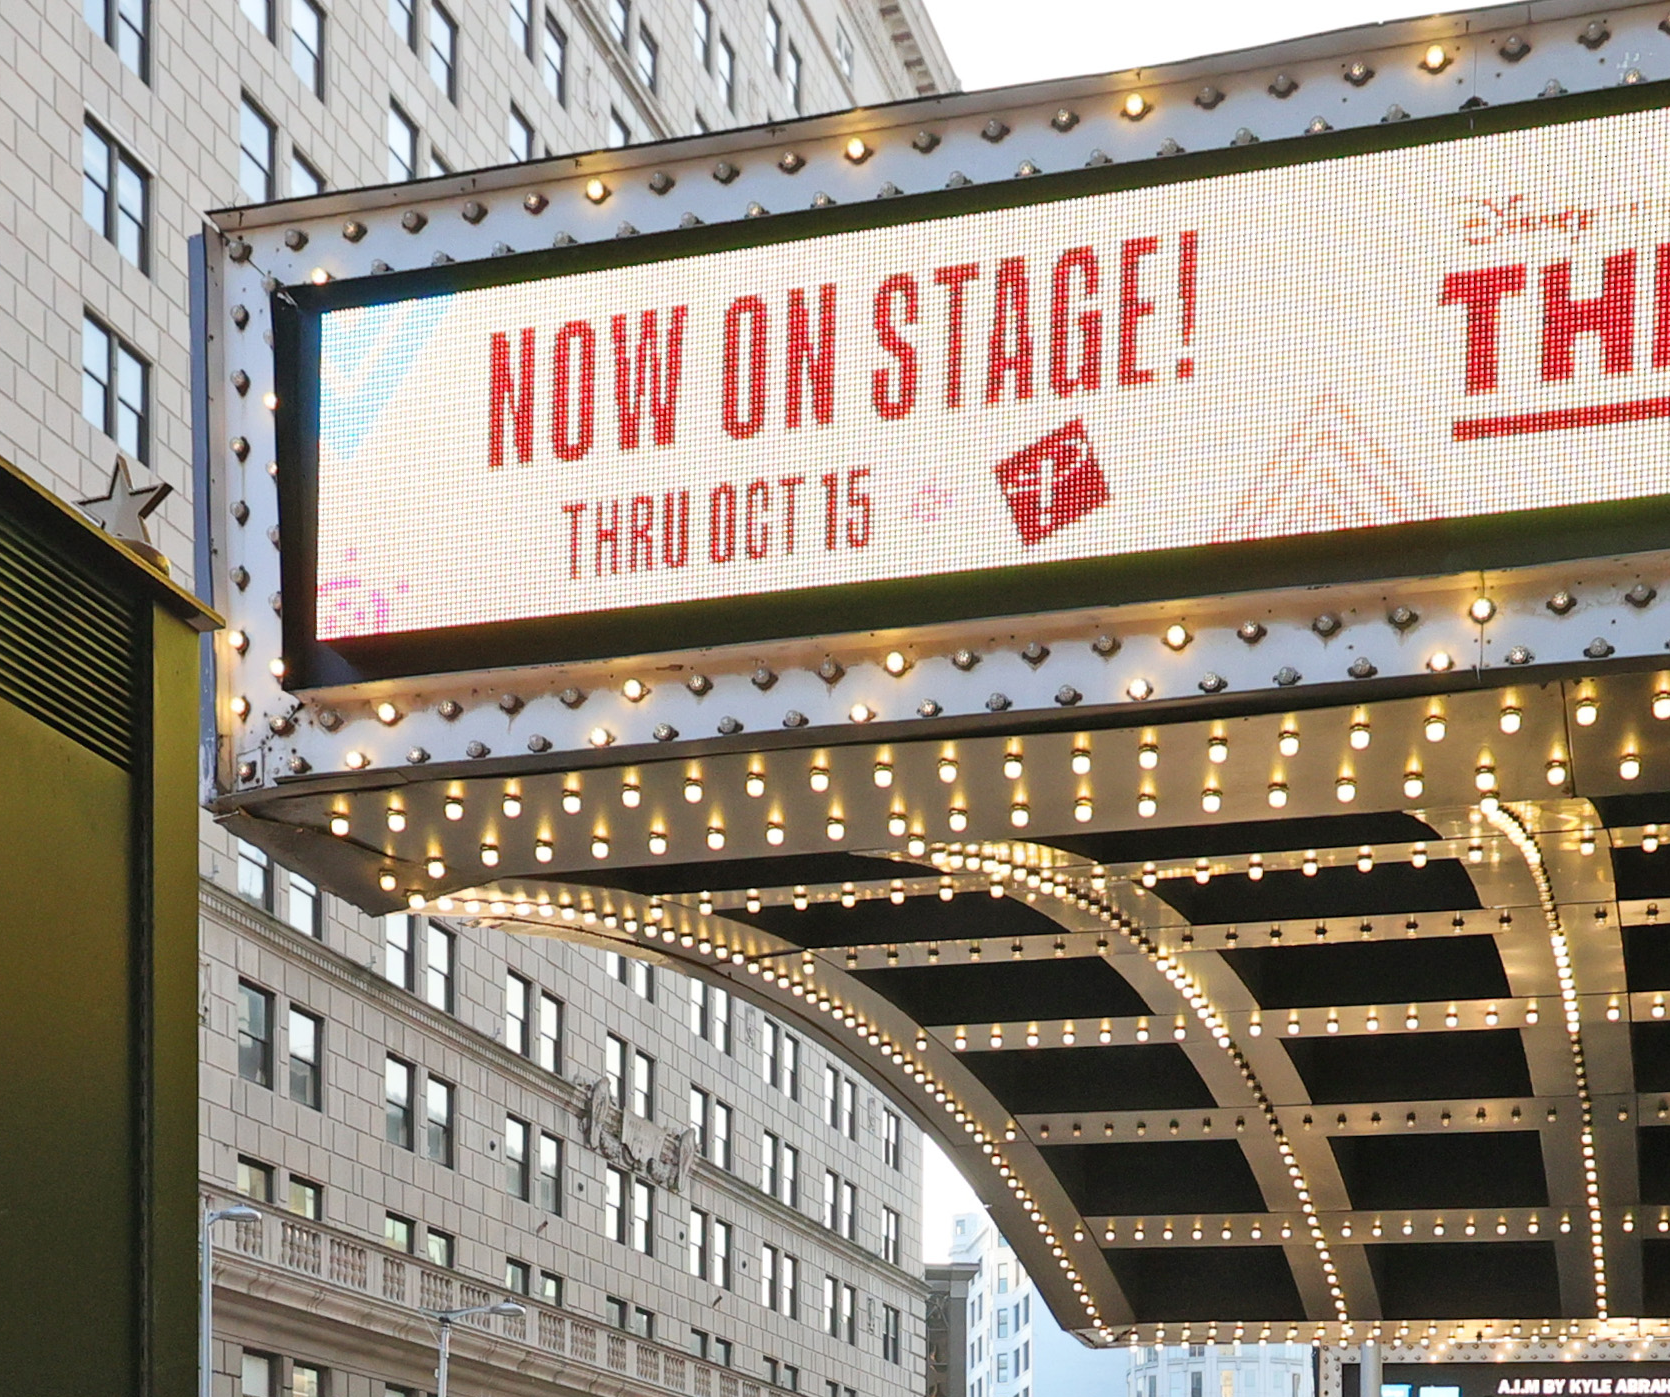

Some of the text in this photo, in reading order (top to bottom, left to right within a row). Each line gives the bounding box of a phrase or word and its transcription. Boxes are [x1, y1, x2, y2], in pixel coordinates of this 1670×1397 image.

[486, 228, 1199, 470] NOW ON STAGE!
[562, 464, 874, 580] THRU OCT 15
[1497, 1379, 1540, 1394] A.I.M
[1542, 1379, 1565, 1394] BY
[1569, 1379, 1612, 1394] KYLE
